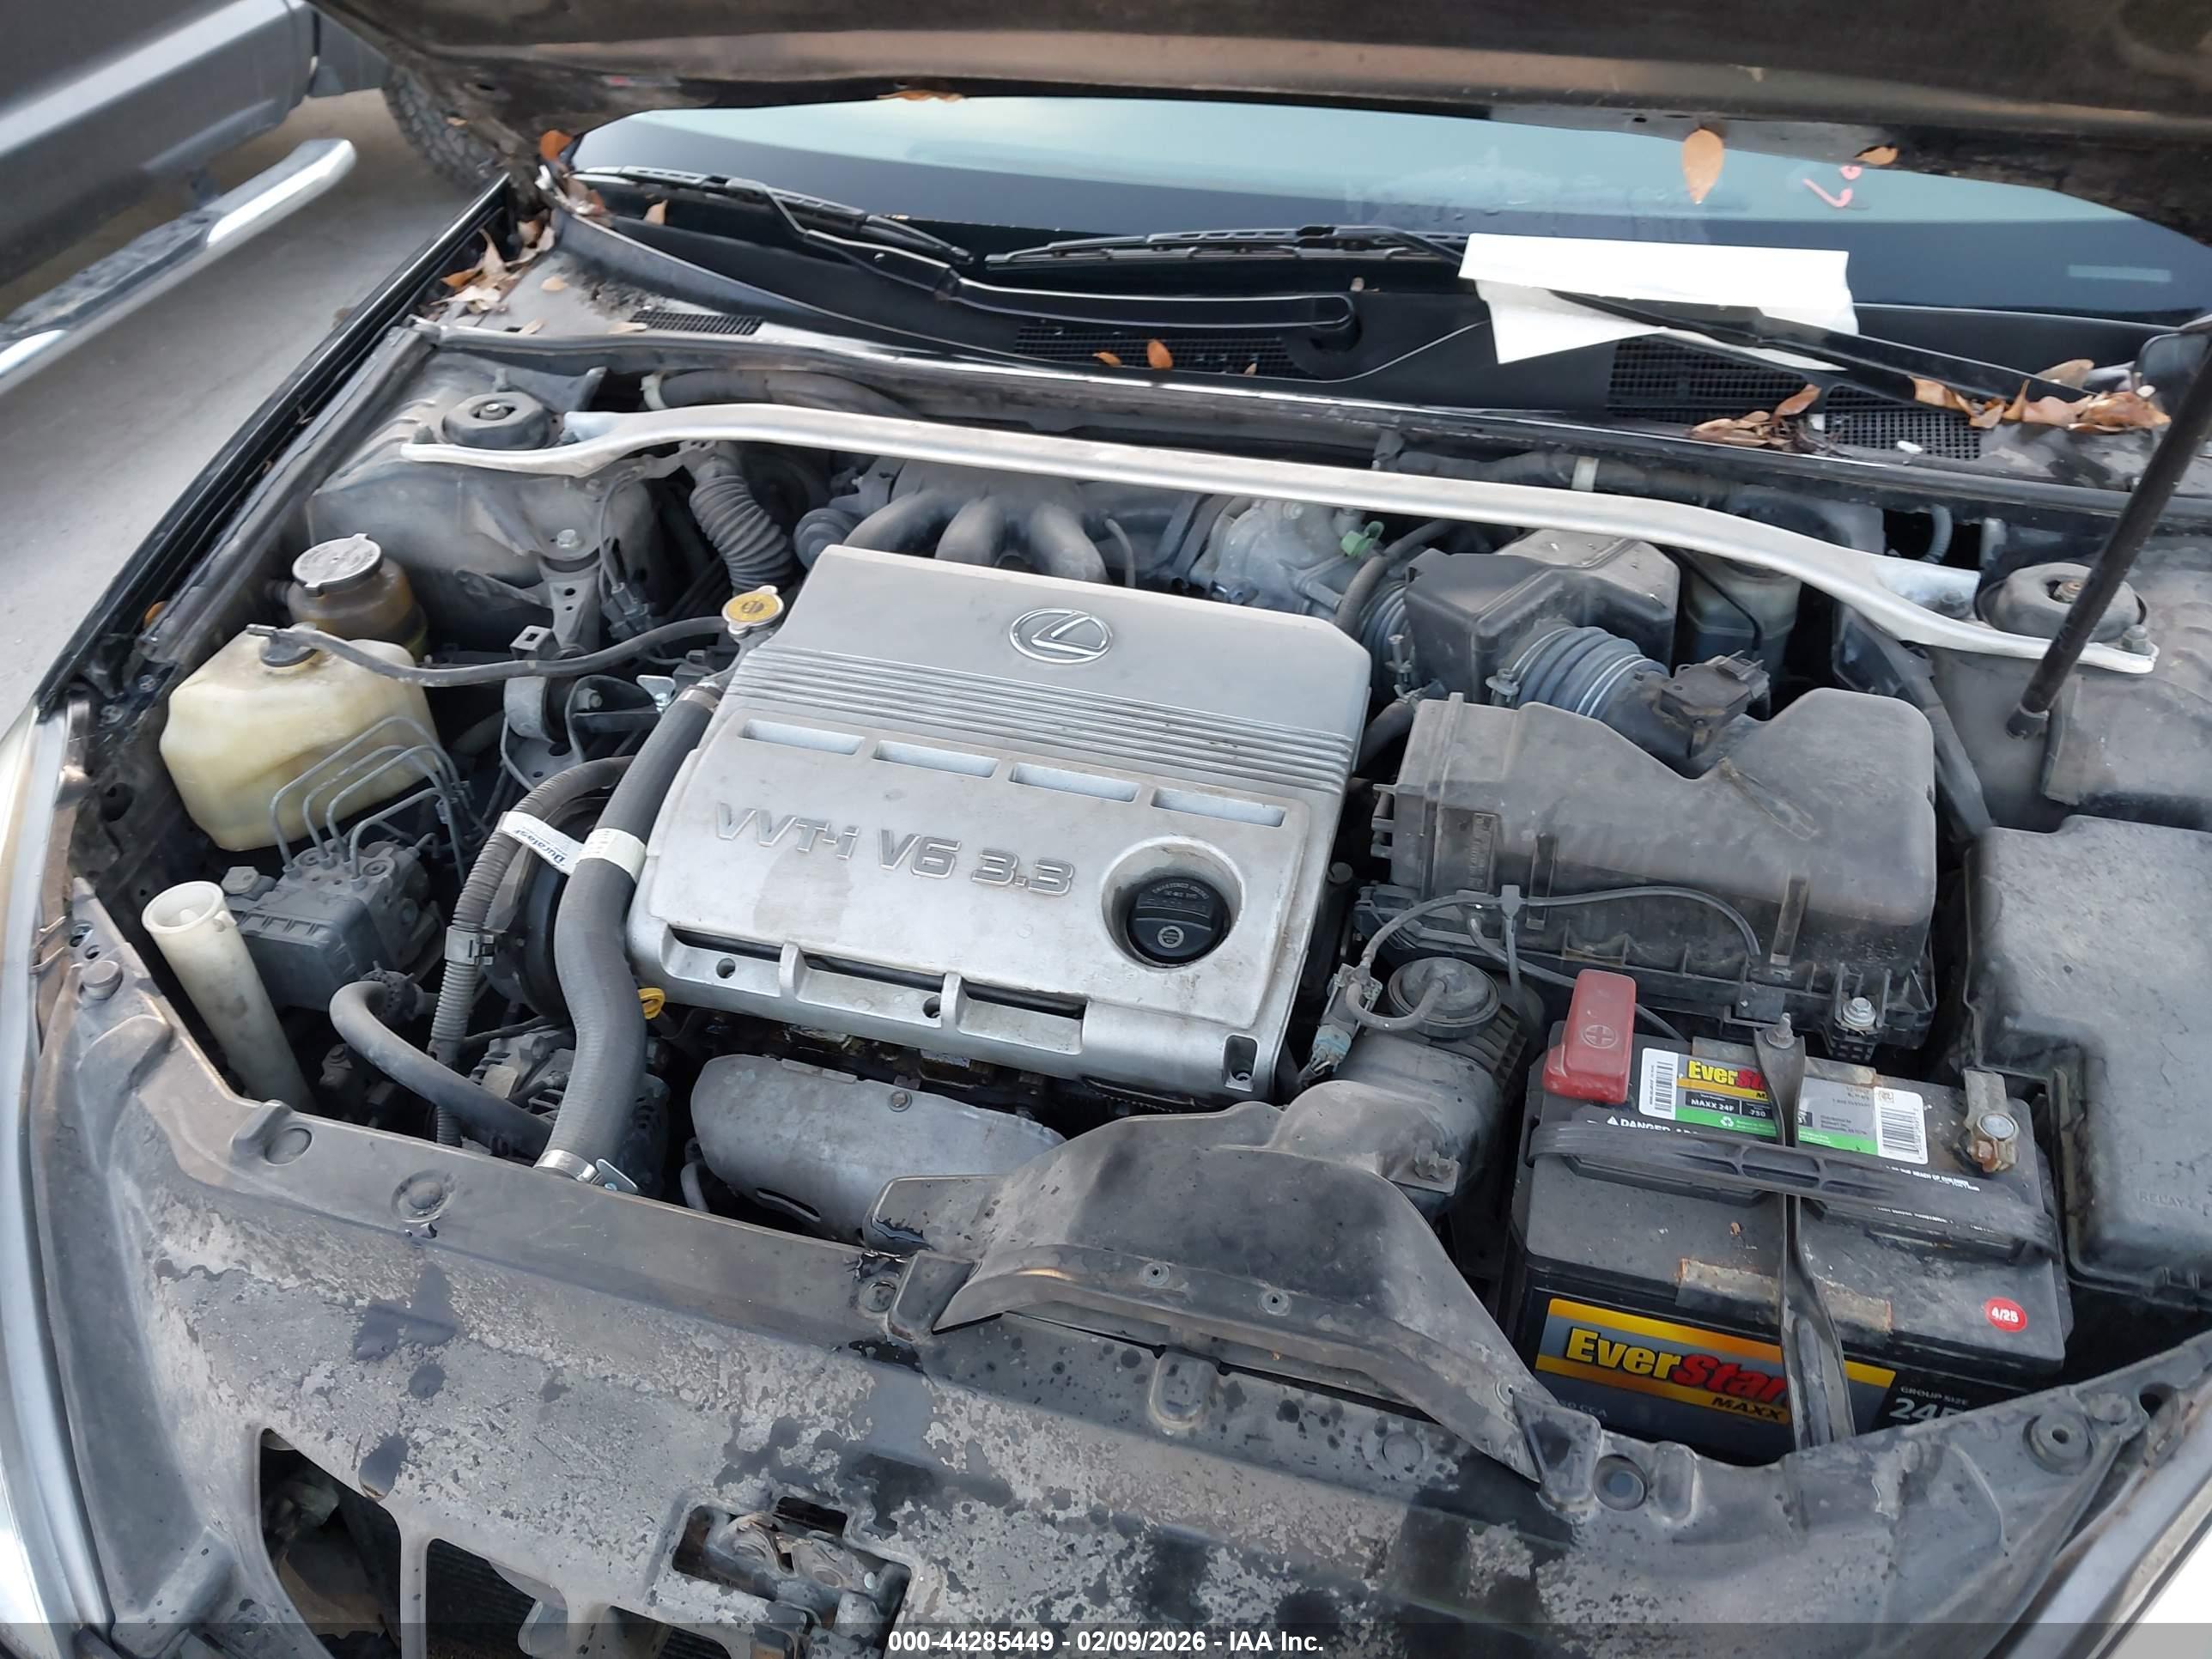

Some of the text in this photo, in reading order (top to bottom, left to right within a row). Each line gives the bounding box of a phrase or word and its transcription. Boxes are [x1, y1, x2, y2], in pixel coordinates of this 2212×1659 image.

[716, 802, 1077, 896] VVT-i V6 3.3
[1687, 1060, 1766, 1090] EverSt
[1691, 1098, 1717, 1109] MAXX
[1565, 1327, 1788, 1403] EverStar
[1711, 1395, 1785, 1422] MAXX
[1899, 1386, 1969, 1406] GROUP SIZE
